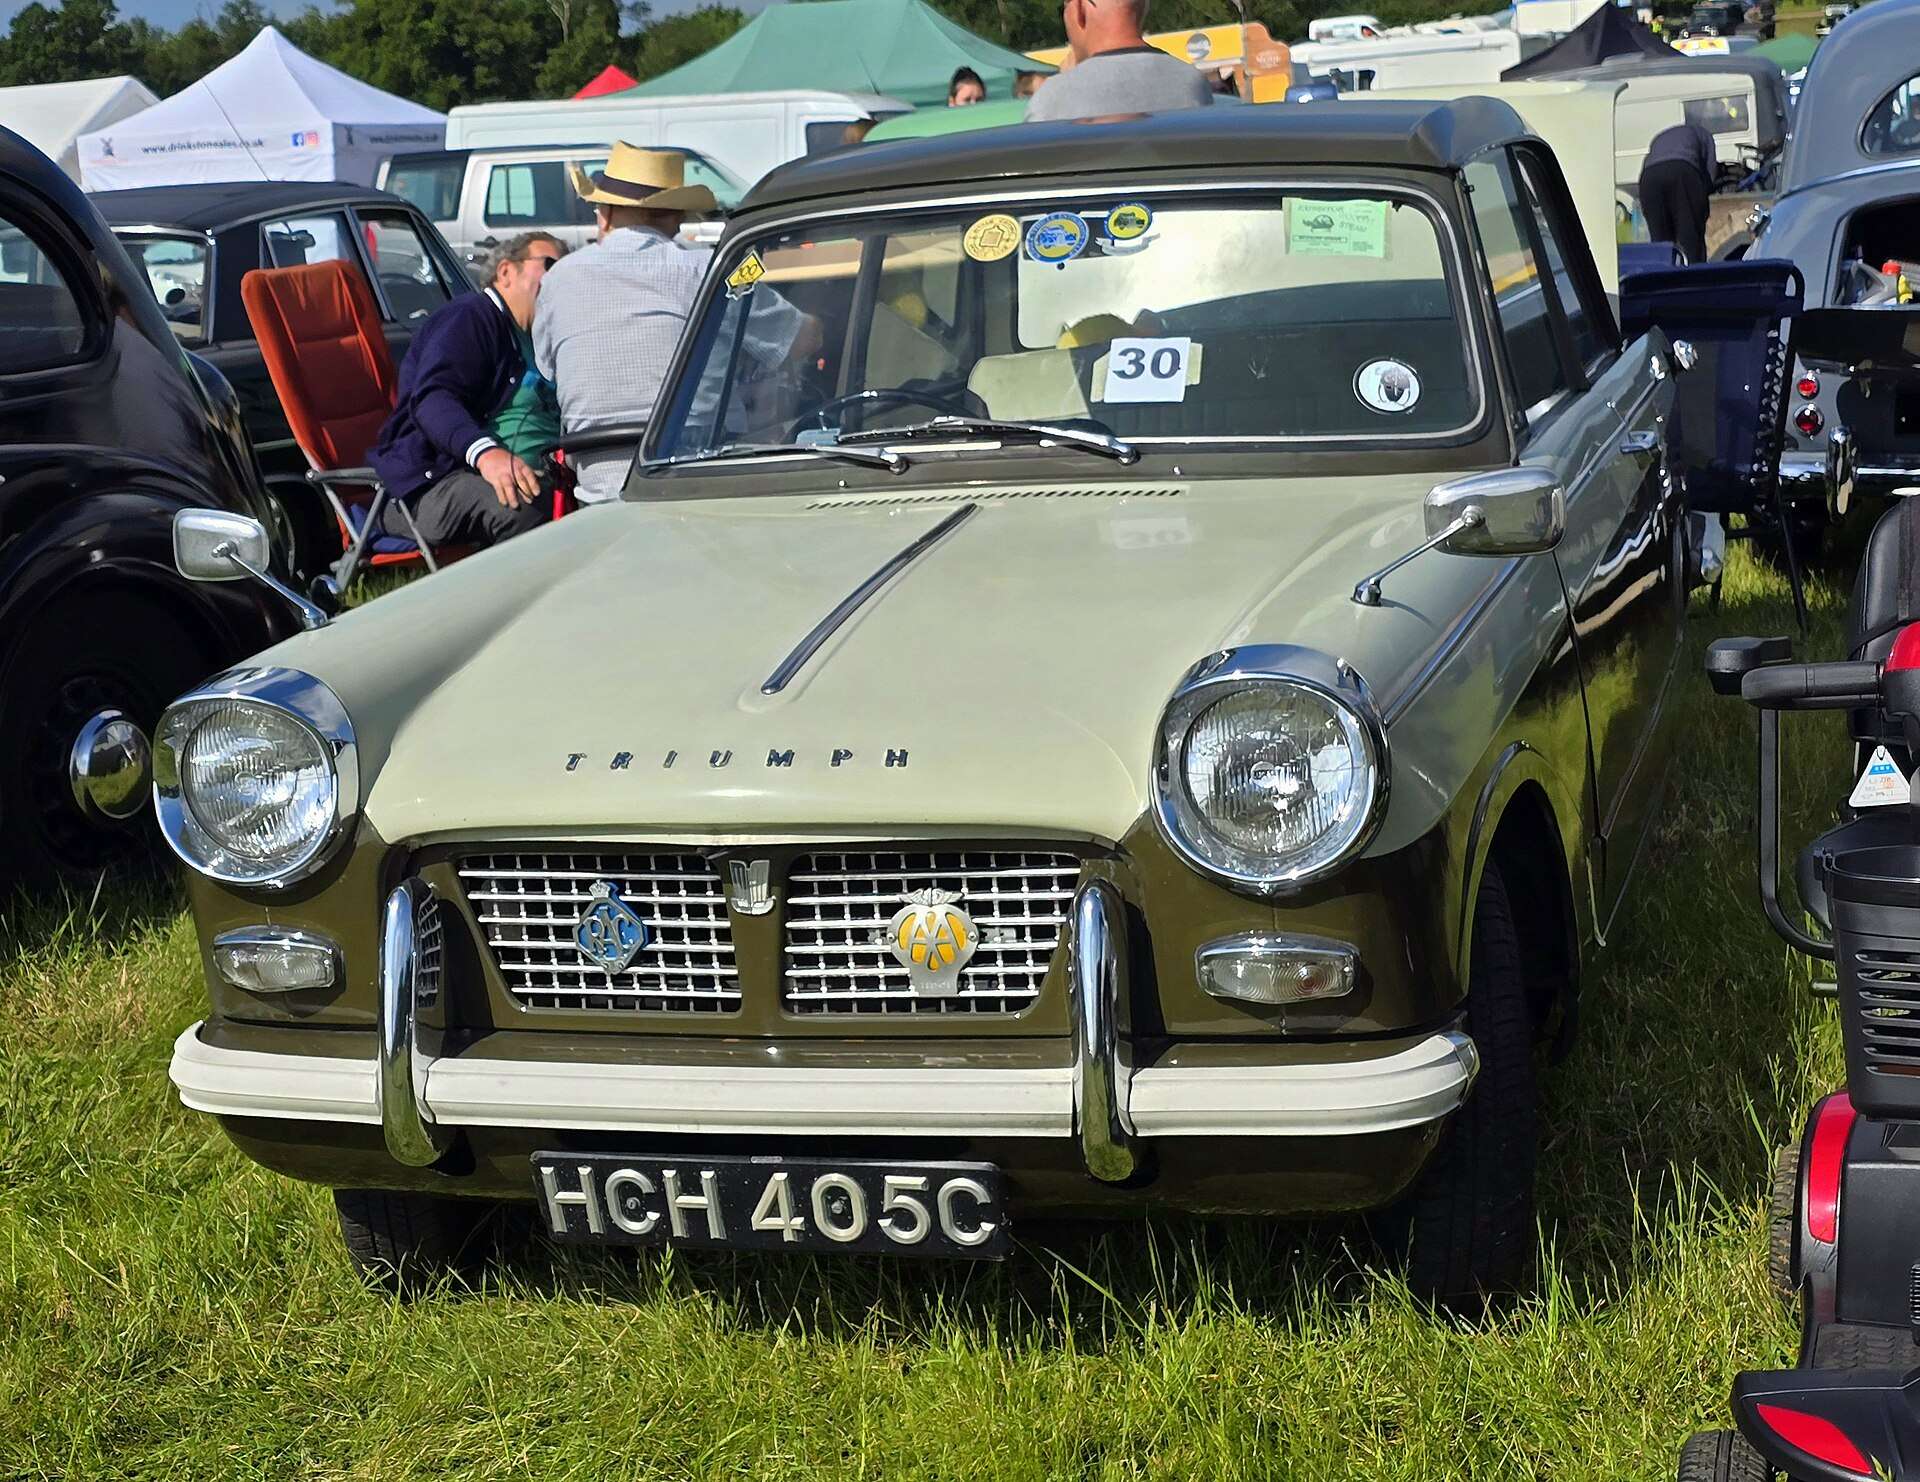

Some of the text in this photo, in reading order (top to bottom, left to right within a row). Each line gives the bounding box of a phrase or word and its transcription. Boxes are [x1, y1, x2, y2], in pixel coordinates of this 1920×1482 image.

[1112, 347, 1181, 379] 30
[565, 749, 909, 772] TRIUMPH
[582, 904, 637, 958] RAC
[903, 908, 962, 968] AA
[540, 1166, 996, 1247] HCH 405C
